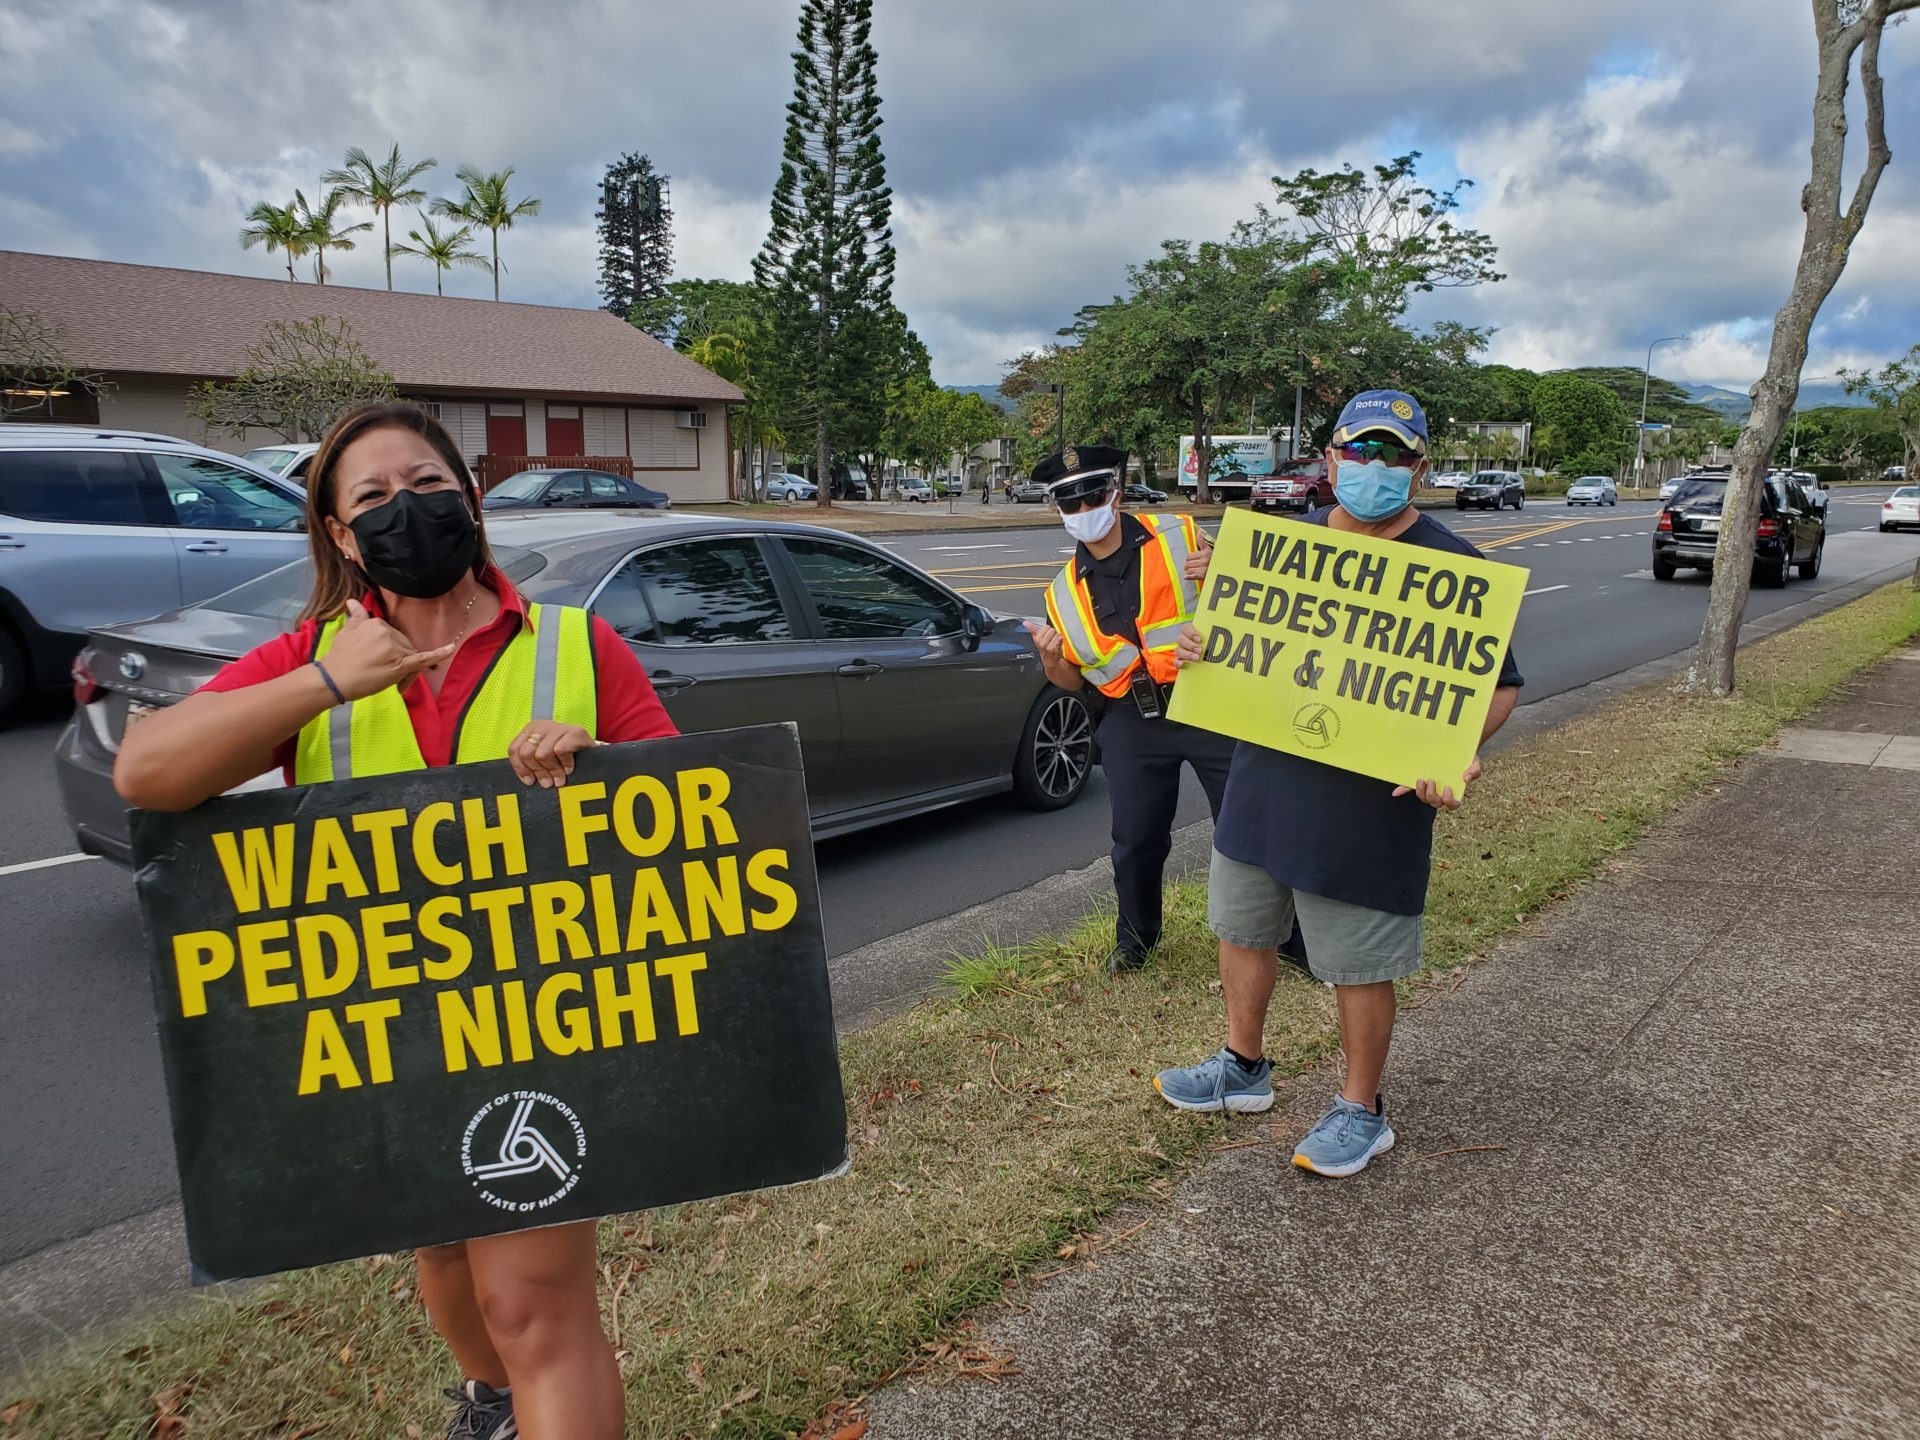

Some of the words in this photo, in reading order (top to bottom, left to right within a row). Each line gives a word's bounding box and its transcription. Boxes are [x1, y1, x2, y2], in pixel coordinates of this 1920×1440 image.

[1355, 400, 1390, 410] Rotary
[1249, 530, 1389, 595] WATCH
[1397, 563, 1490, 618] FOR
[1203, 625, 1285, 677] DAY
[1293, 650, 1324, 690] &
[1336, 659, 1476, 726] NIGHT
[1207, 574, 1500, 676] PEDESTRIANS
[212, 794, 528, 913] WATCH
[558, 767, 739, 867] FOR
[173, 849, 798, 1017] PEDESTRIANS
[298, 999, 401, 1095] AT
[437, 952, 708, 1072] NIGHT
[461, 1102, 493, 1175] DEPARTMENT
[494, 1093, 510, 1106] OF
[512, 1090, 587, 1156] TRANSPORTATION
[480, 1190, 516, 1211] STATE
[519, 1201, 536, 1212] OF
[539, 1174, 580, 1209] HAWAII
